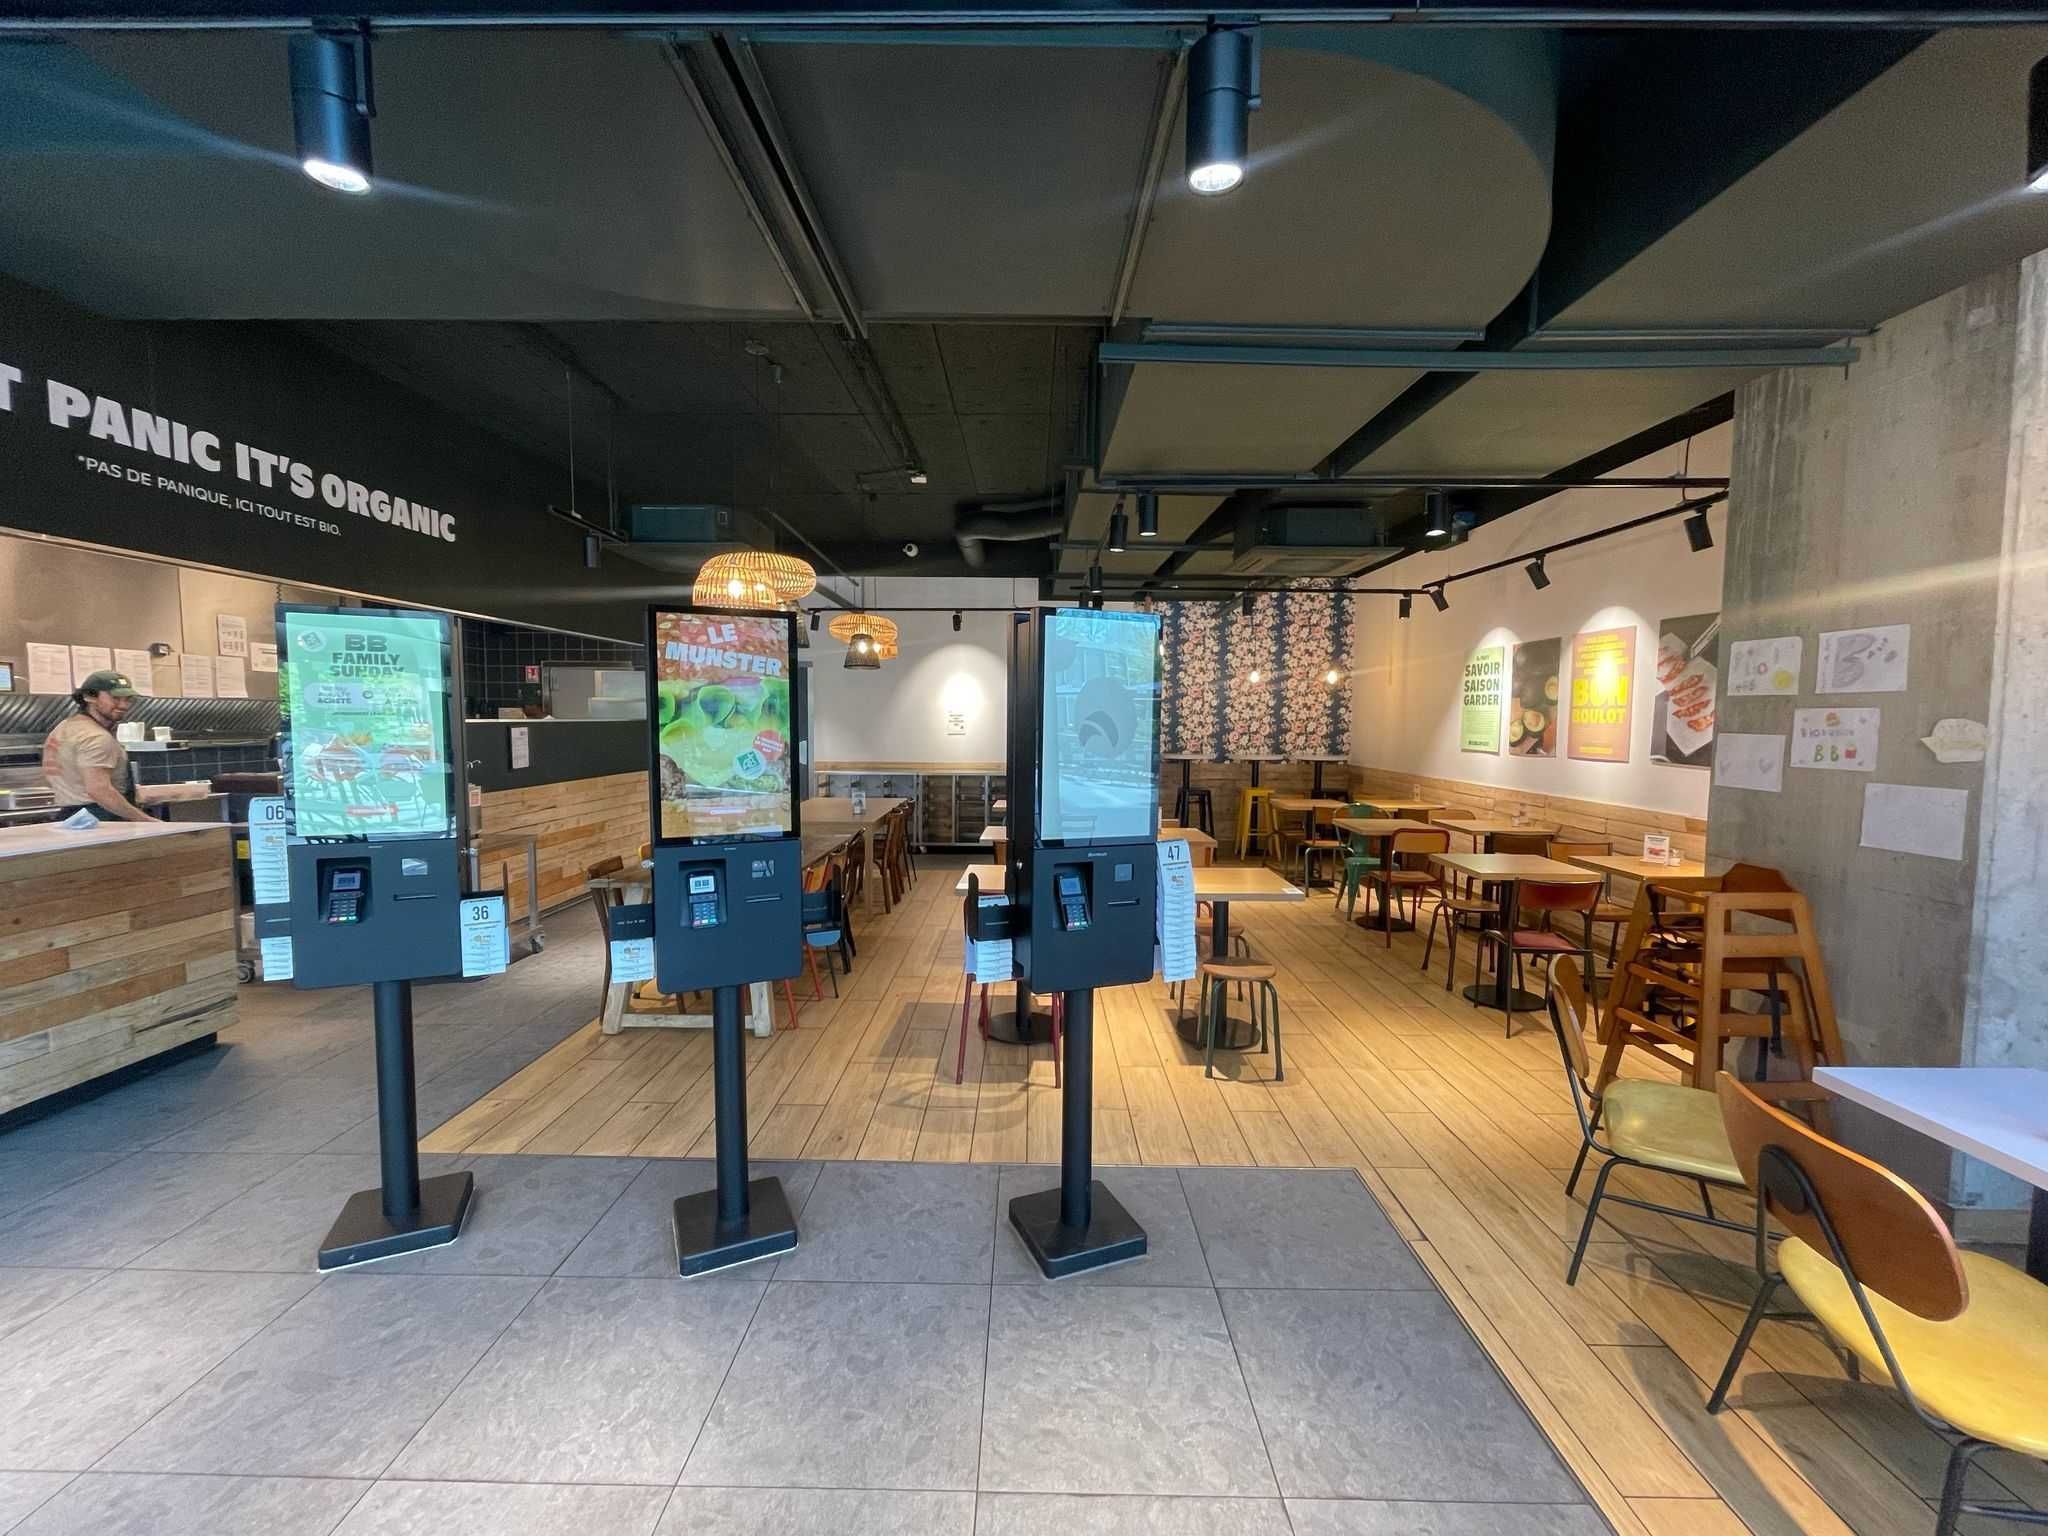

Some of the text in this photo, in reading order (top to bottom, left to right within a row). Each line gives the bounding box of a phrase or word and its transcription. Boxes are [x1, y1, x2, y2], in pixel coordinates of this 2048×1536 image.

[47, 379, 221, 472] PANIC
[235, 442, 315, 499] IT'S
[321, 473, 456, 542] ORGANIC
[126, 468, 153, 486] DE
[157, 476, 233, 509] PANIQUE,
[235, 497, 254, 513] ICI
[255, 503, 292, 522] TOUT
[294, 514, 317, 528] EST
[319, 521, 342, 536] BIO.
[707, 623, 738, 645] LE
[345, 634, 388, 652] BB
[332, 652, 401, 666] FAMILY
[665, 641, 782, 676] MUNSTER
[329, 665, 405, 678] SUNDAY
[1464, 662, 1501, 677] SAVOIR
[1463, 678, 1500, 693] SAISON
[1463, 694, 1499, 706] GARDER
[265, 805, 285, 820] 06
[1167, 845, 1180, 861] 47
[472, 905, 489, 921] 36
